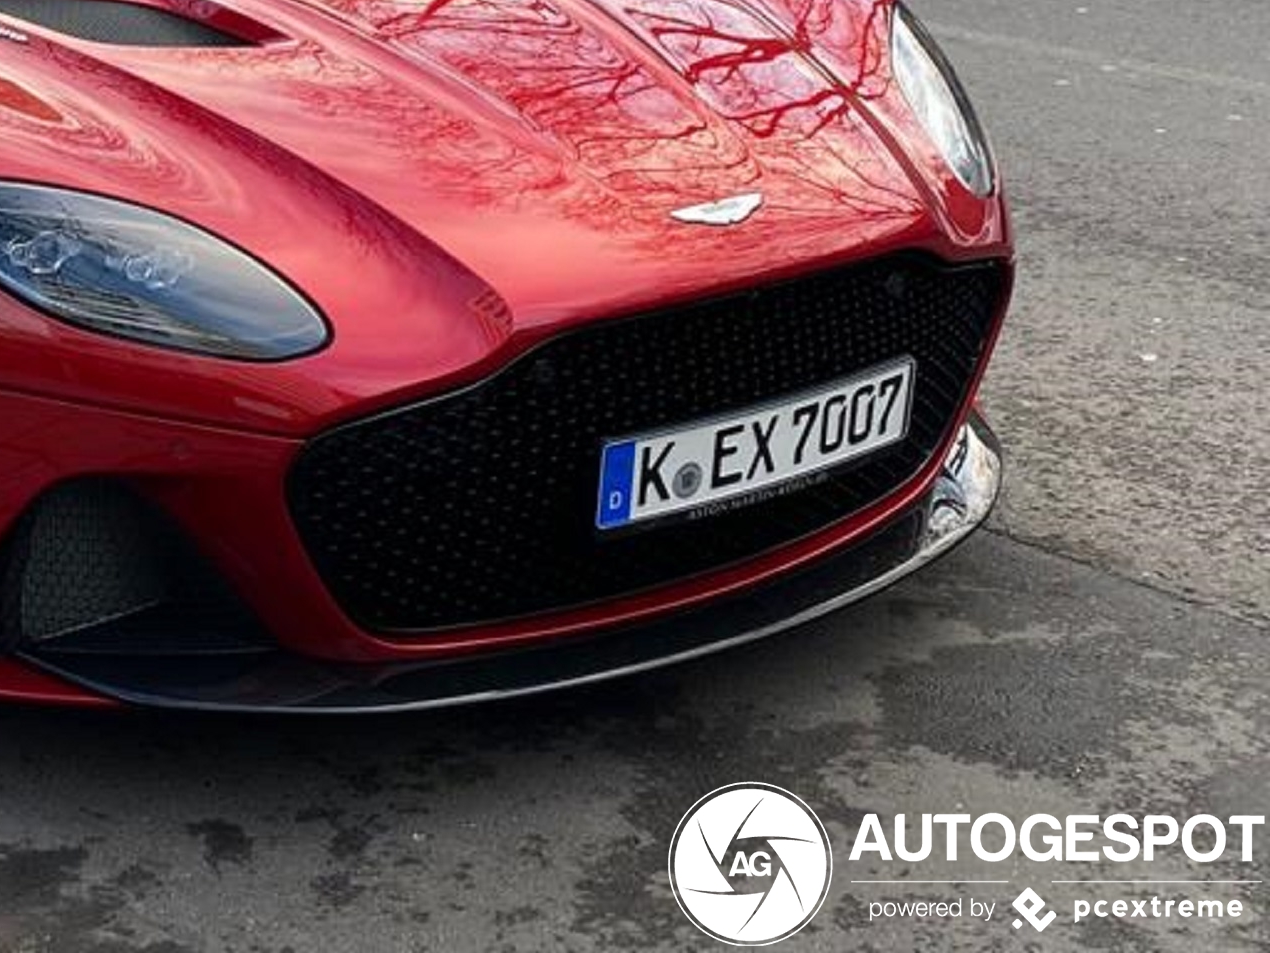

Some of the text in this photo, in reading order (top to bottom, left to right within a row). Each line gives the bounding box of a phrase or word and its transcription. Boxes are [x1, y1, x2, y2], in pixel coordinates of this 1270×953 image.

[609, 374, 904, 510] D K EX 7007
